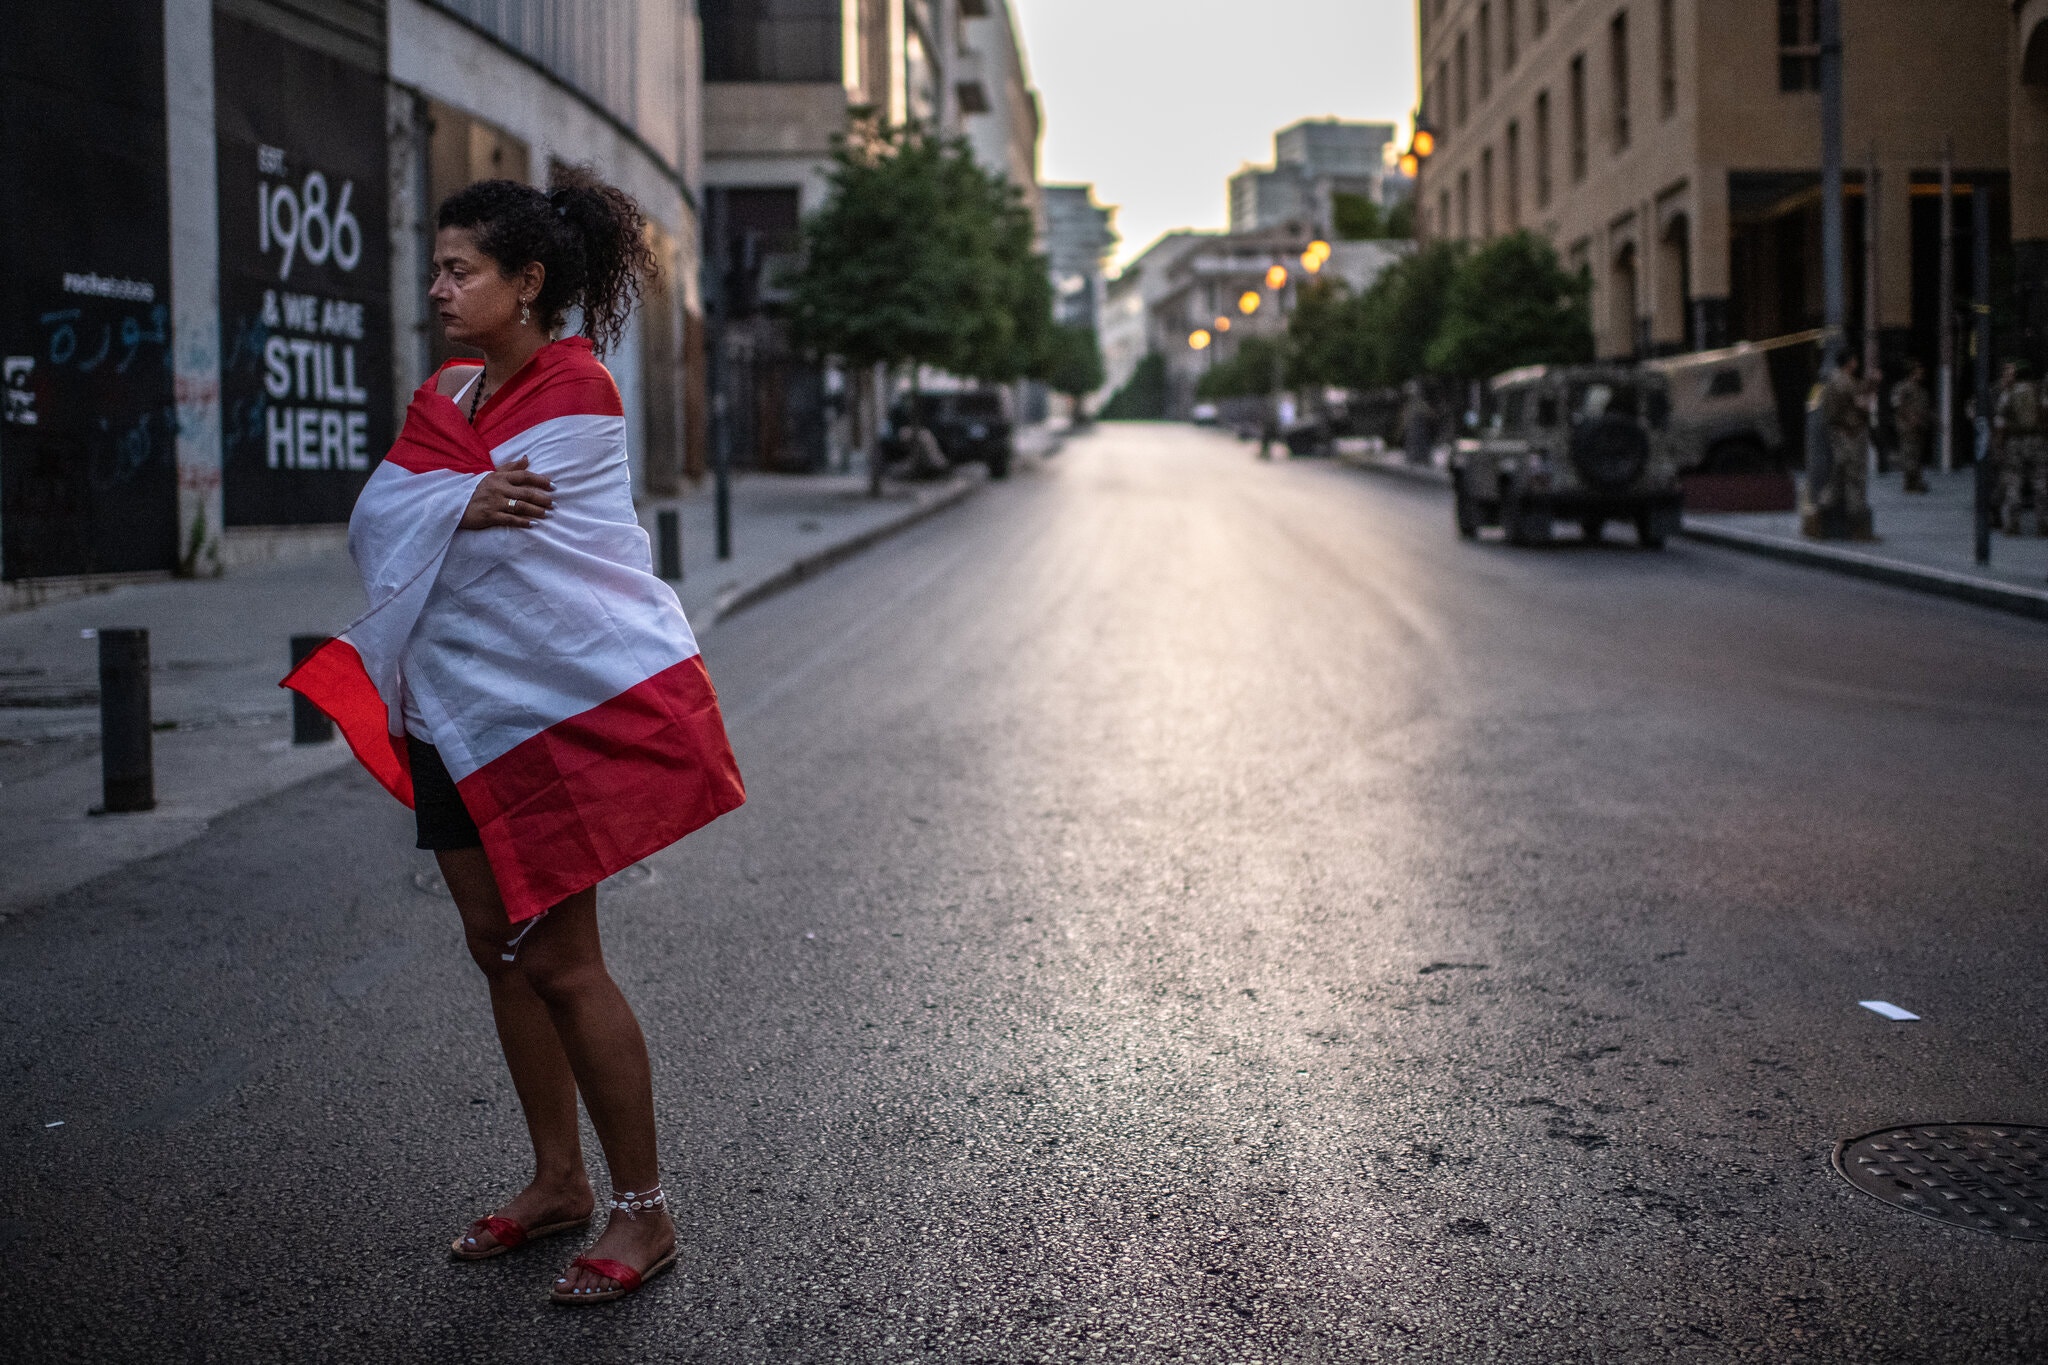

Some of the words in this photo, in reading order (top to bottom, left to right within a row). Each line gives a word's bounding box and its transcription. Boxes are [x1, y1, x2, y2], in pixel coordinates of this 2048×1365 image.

[258, 171, 362, 281] 1986
[262, 288, 280, 328] &
[282, 292, 318, 333] WE
[321, 300, 364, 340] ARE
[263, 335, 367, 404] STILL
[266, 405, 369, 471] HERE
